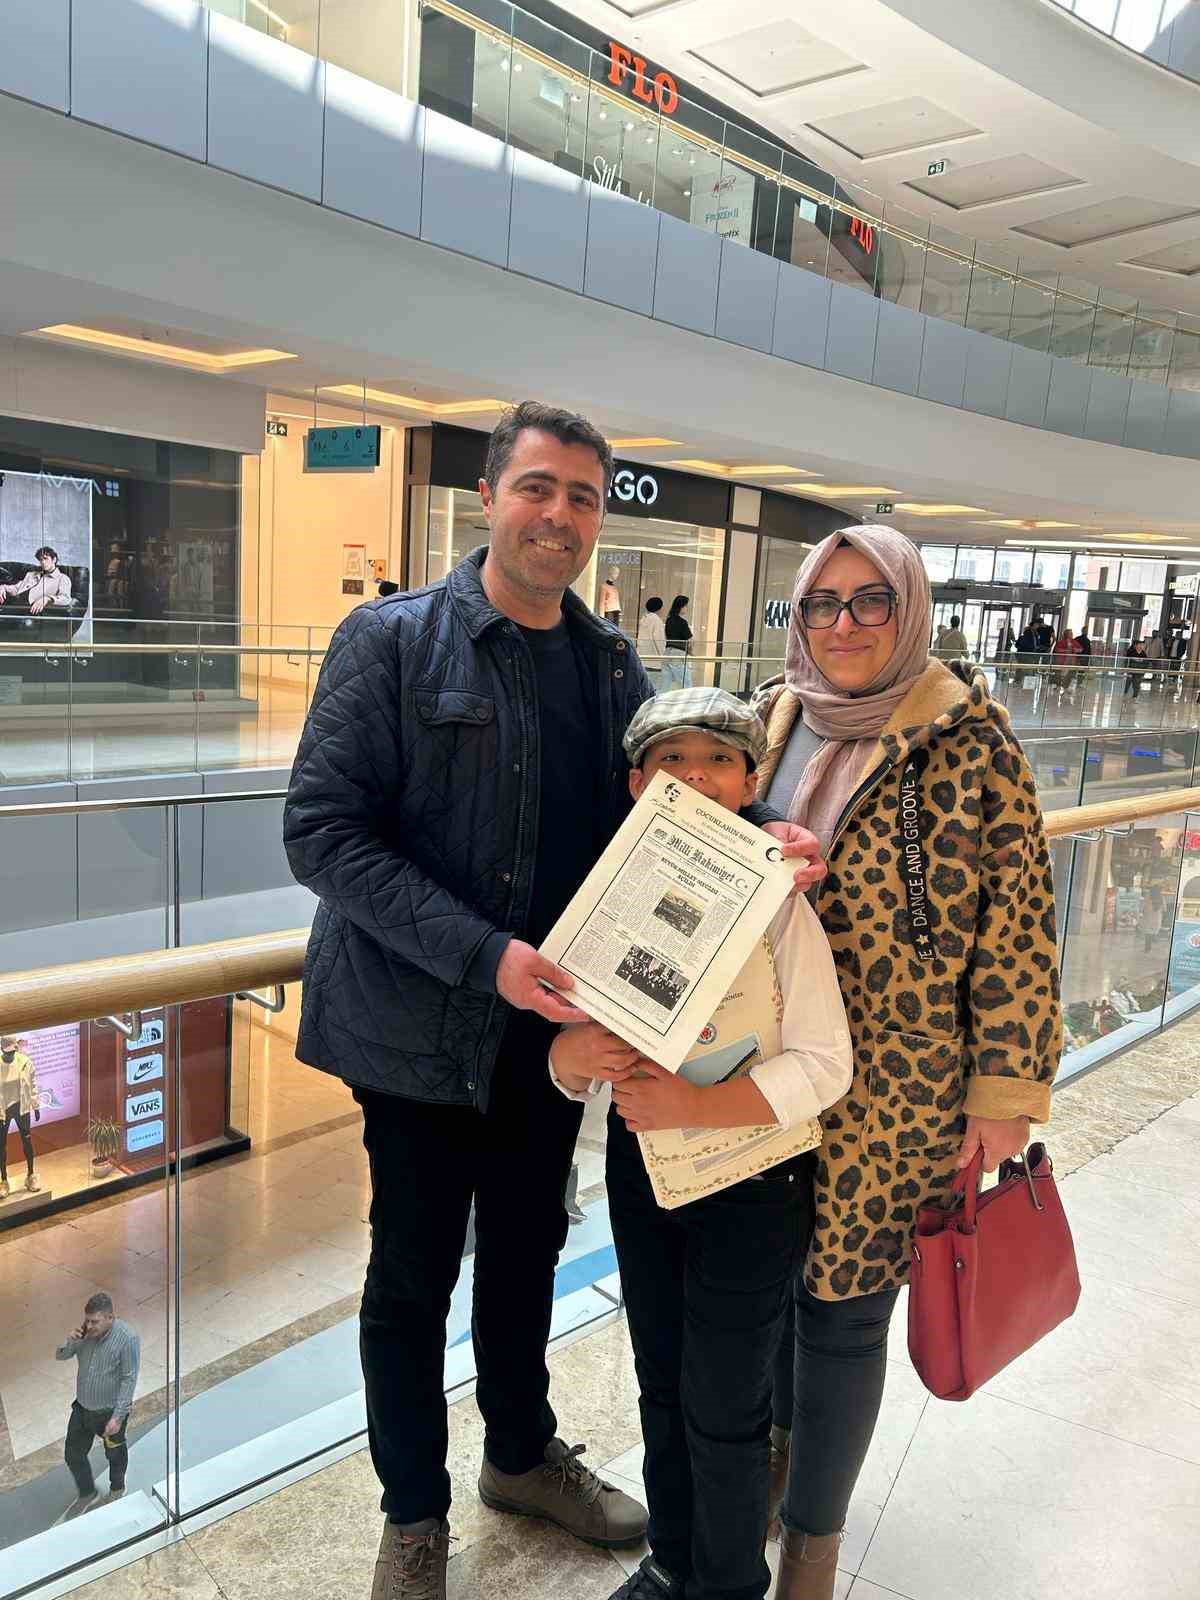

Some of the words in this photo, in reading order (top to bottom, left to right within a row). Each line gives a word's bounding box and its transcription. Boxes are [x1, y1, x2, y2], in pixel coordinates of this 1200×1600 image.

[608, 41, 679, 113] FLO
[850, 216, 873, 255] FLO
[608, 470, 658, 505] GO
[902, 779, 920, 841] GROOVE
[905, 843, 922, 874] AND
[909, 877, 927, 927] DANCE
[131, 1099, 160, 1116] VANS
